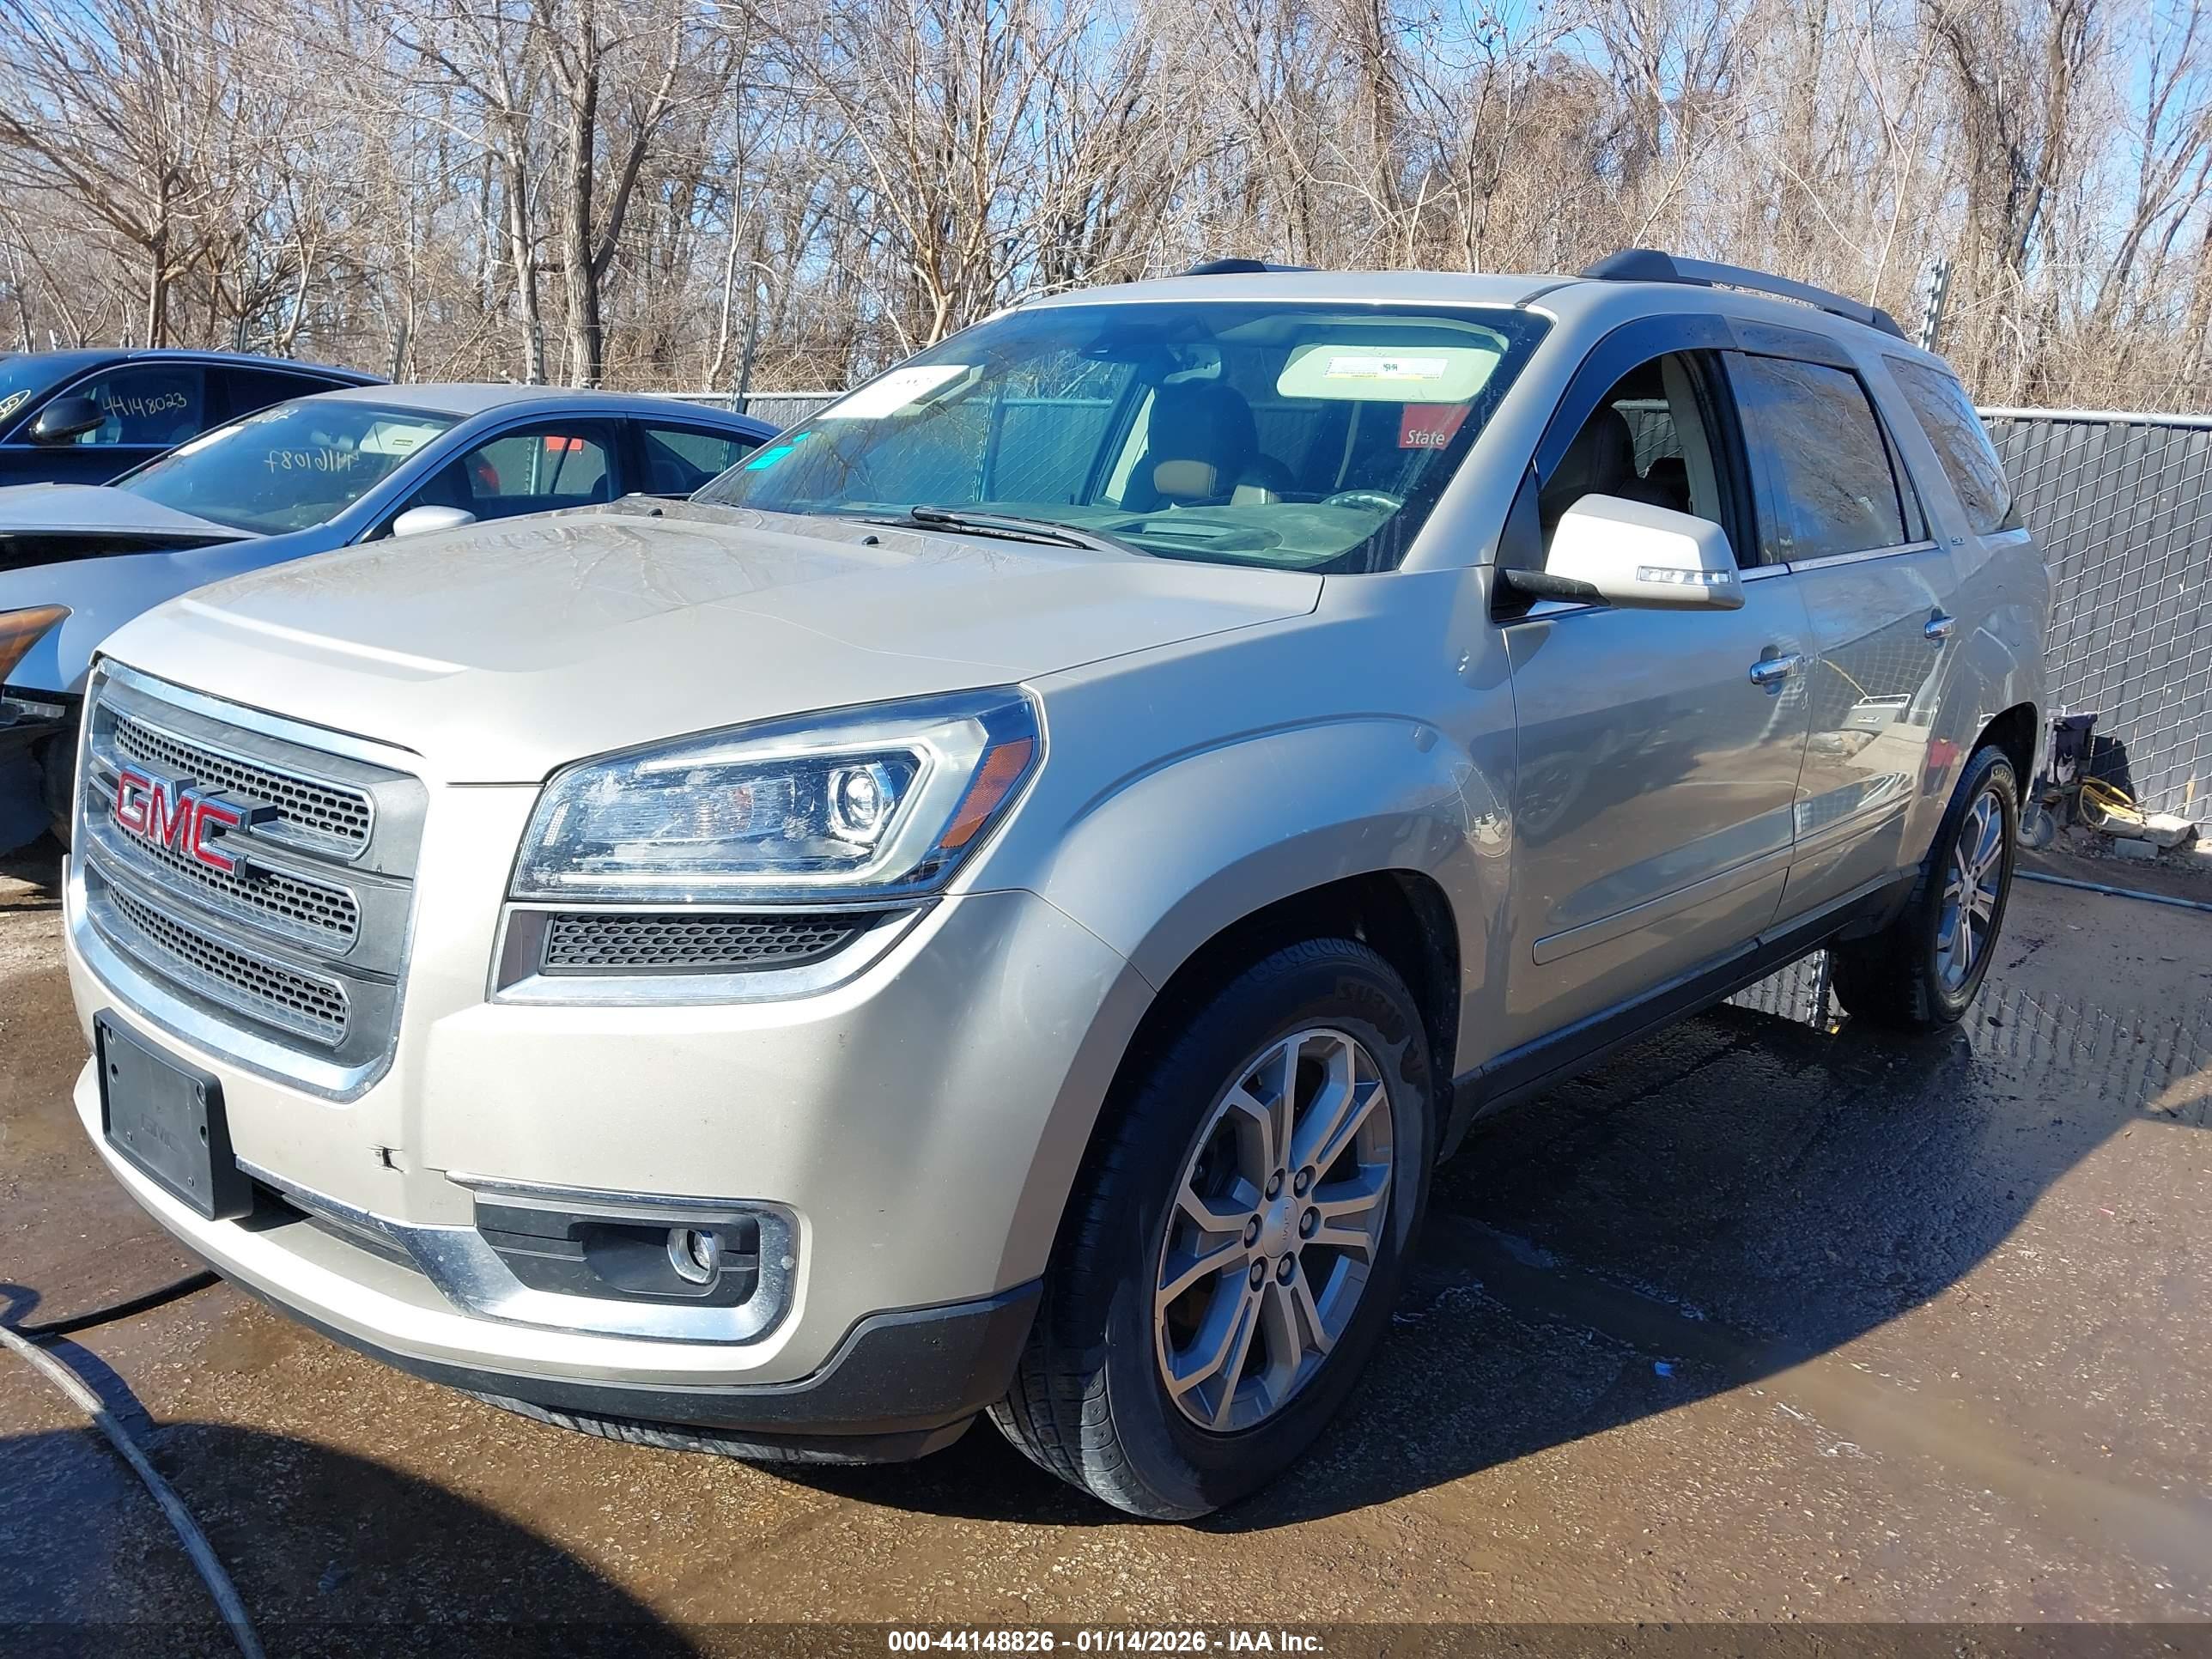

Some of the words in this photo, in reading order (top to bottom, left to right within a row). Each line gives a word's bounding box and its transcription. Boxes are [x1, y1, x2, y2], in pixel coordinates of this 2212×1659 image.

[103, 392, 187, 418] 44148023
[1406, 429, 1445, 445] State
[117, 764, 246, 876] GMC
